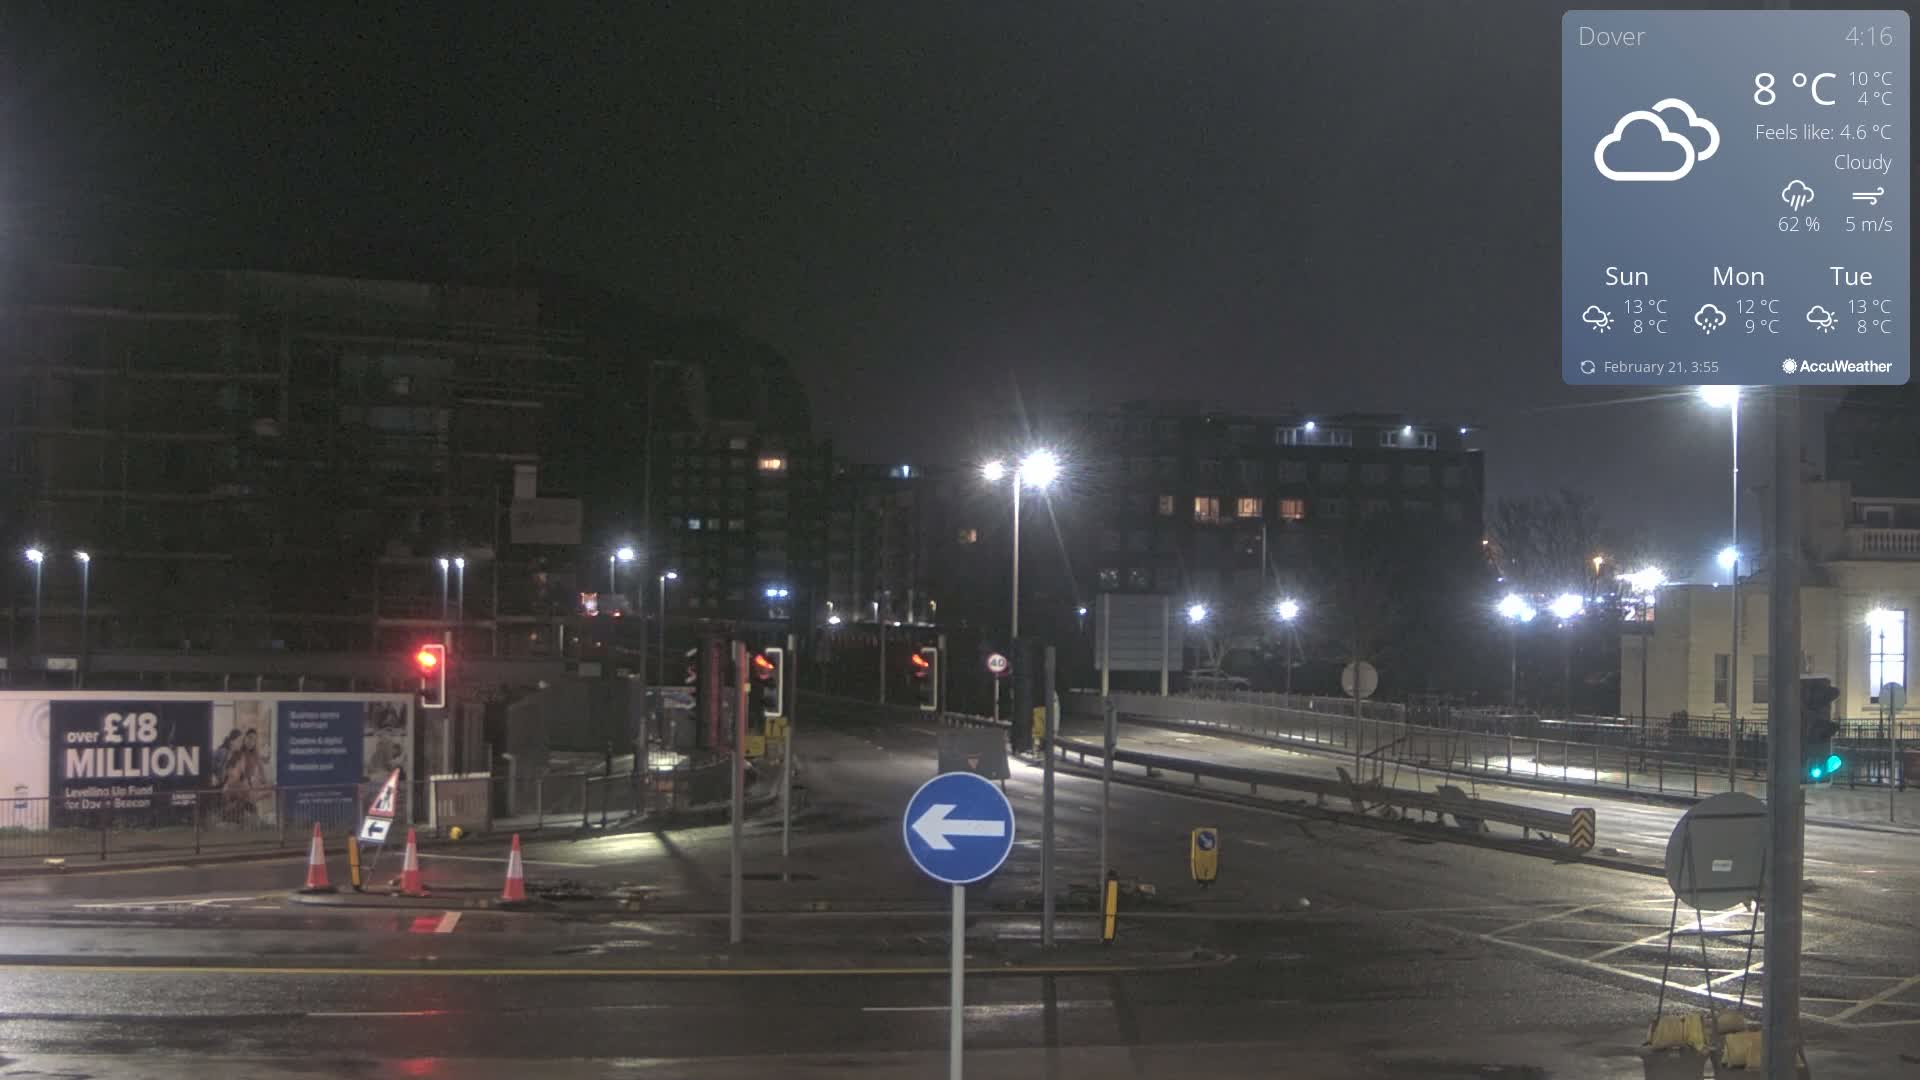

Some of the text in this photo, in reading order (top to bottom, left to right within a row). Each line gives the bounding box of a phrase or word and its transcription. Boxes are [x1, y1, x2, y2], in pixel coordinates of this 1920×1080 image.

[991, 658, 1005, 667] 40
[67, 712, 158, 743] over £18
[66, 746, 200, 778] MILLION
